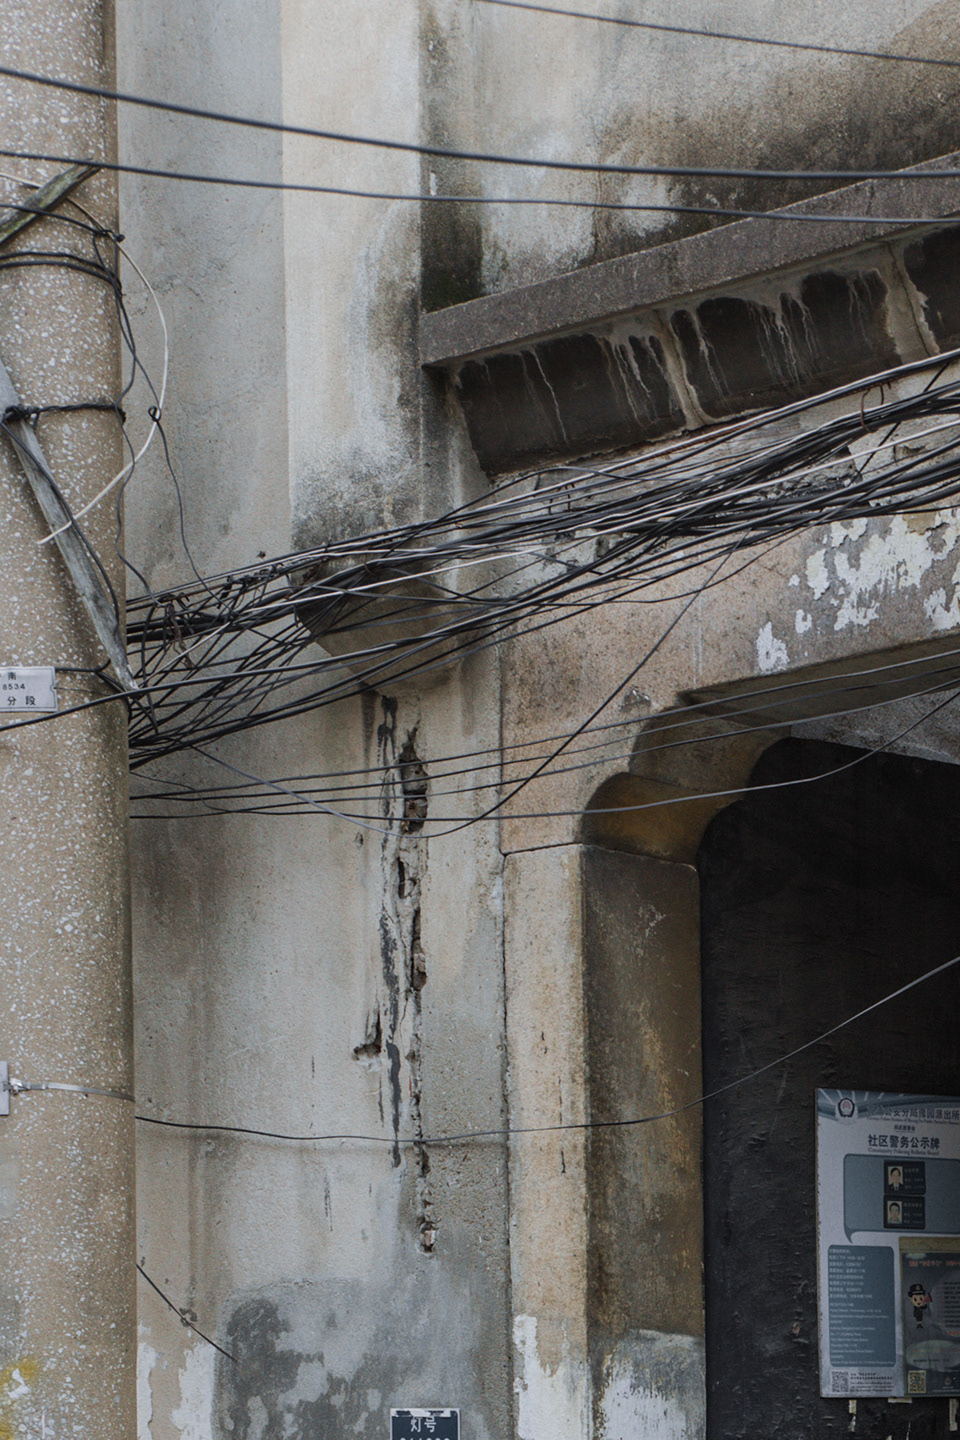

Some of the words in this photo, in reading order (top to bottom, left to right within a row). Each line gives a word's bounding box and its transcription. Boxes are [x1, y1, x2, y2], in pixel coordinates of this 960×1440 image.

[868, 1134, 940, 1150] 社区警务公示牌
[410, 1416, 437, 1433] 灯号
